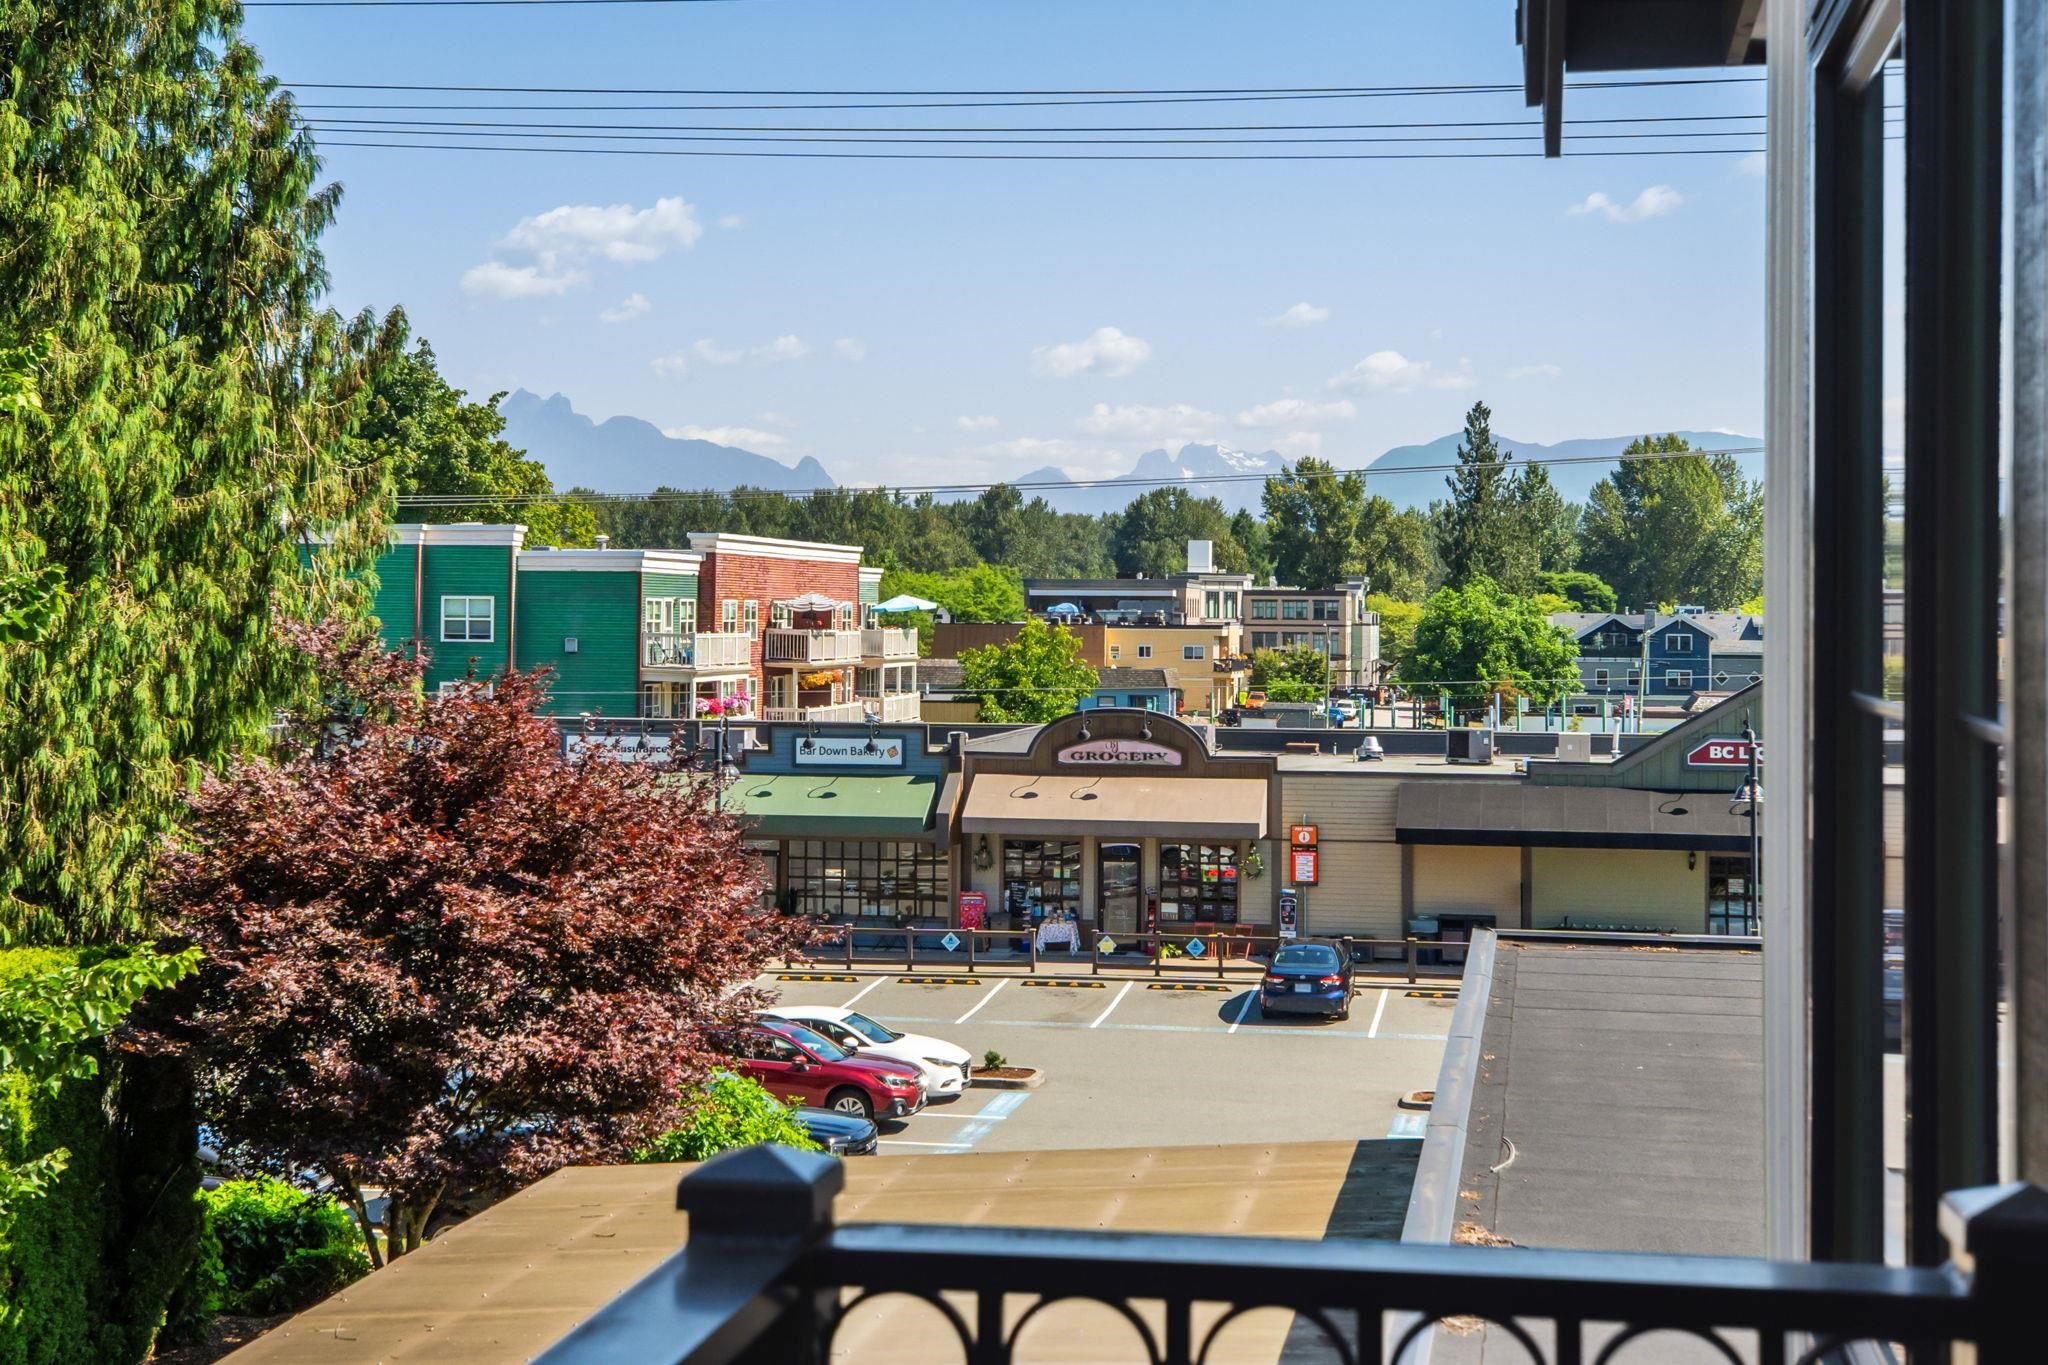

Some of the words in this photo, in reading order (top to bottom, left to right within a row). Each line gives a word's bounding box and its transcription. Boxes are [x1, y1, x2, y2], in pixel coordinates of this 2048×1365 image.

[800, 746, 816, 756] Bar
[819, 746, 848, 756] Down
[1070, 751, 1168, 761] GROCERY
[1709, 746, 1735, 759] BC
